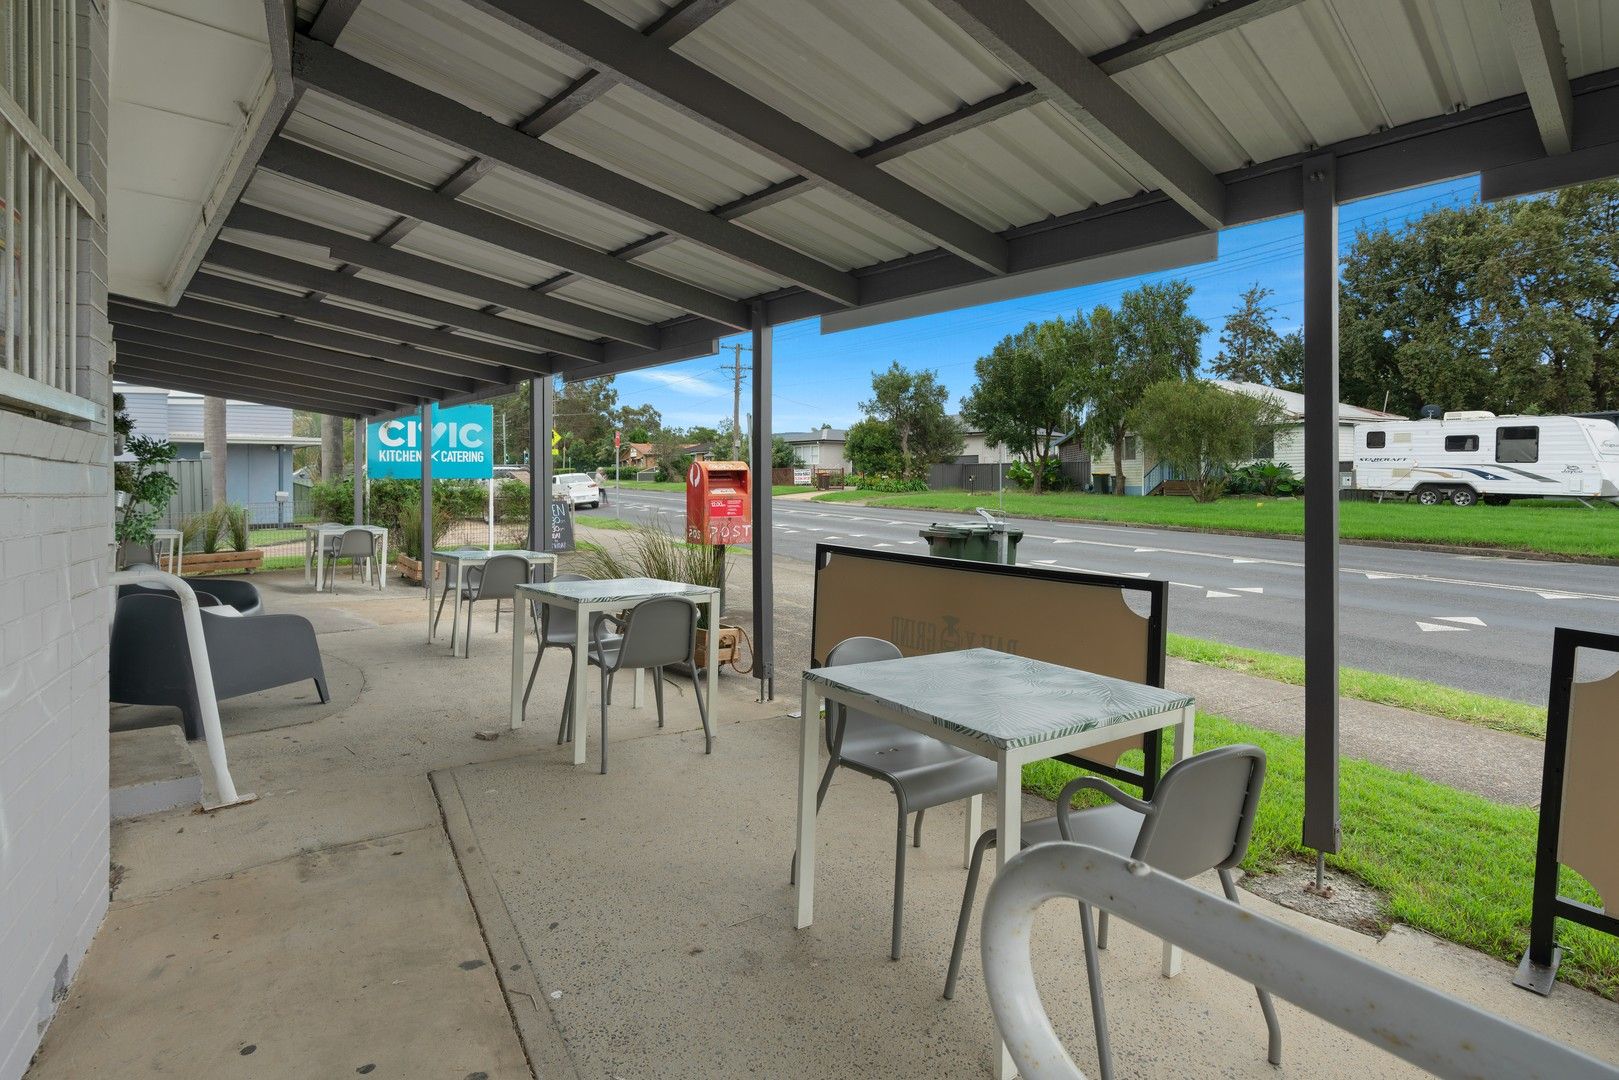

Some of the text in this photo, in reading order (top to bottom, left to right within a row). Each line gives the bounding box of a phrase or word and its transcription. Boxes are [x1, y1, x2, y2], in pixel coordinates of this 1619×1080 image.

[378, 420, 484, 449] CIVIC
[379, 449, 485, 463] KITCHEN CATERING
[709, 524, 752, 539] POST
